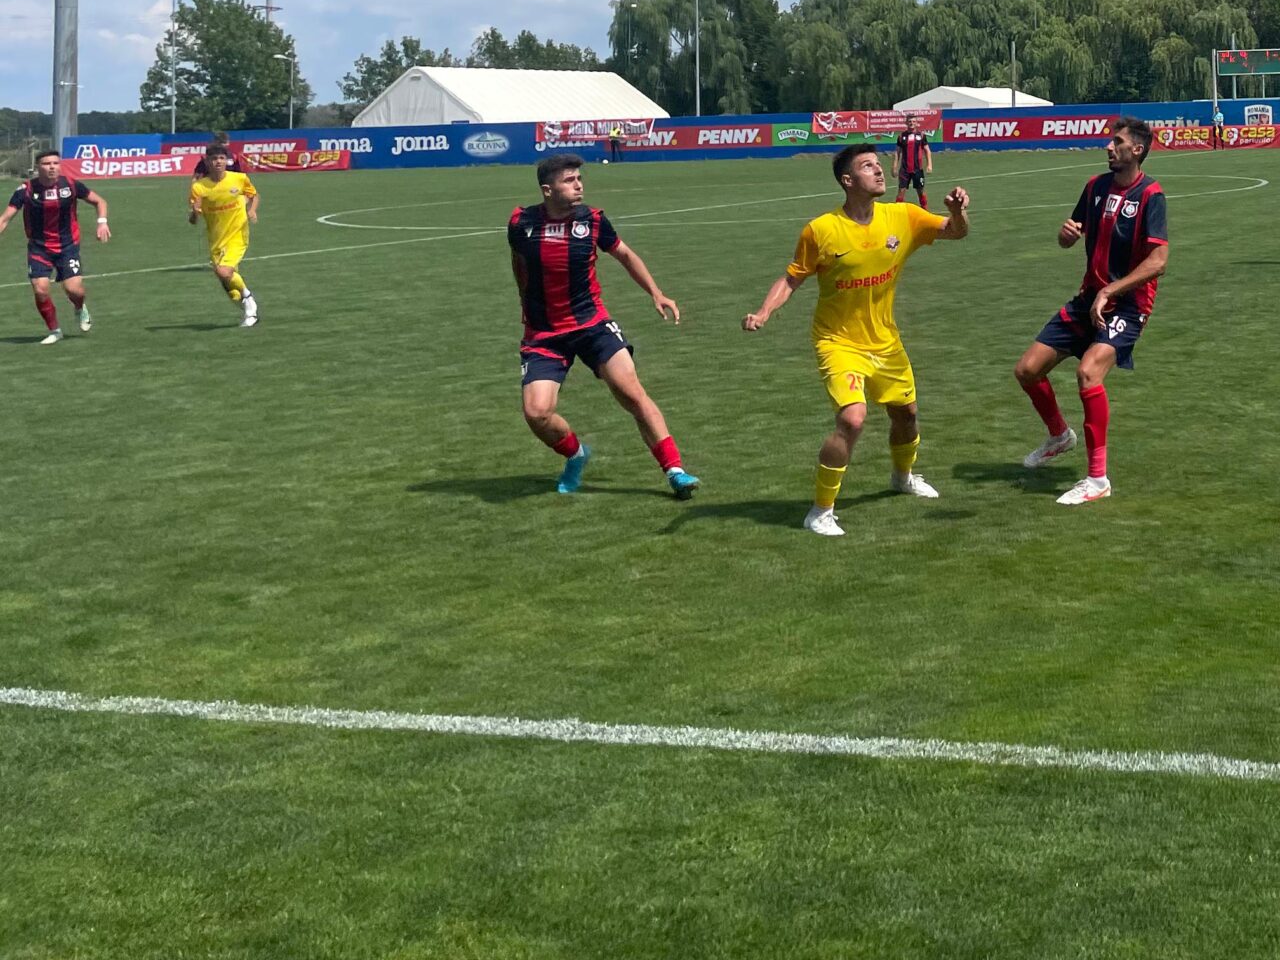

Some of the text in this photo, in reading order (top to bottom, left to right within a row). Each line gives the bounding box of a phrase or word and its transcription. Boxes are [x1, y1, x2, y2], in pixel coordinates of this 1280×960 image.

[1175, 128, 1210, 140] casa
[1240, 126, 1276, 138] casa
[467, 142, 508, 151] BUCOVINA
[80, 156, 184, 176] SUPERBET
[1109, 316, 1127, 332] 16
